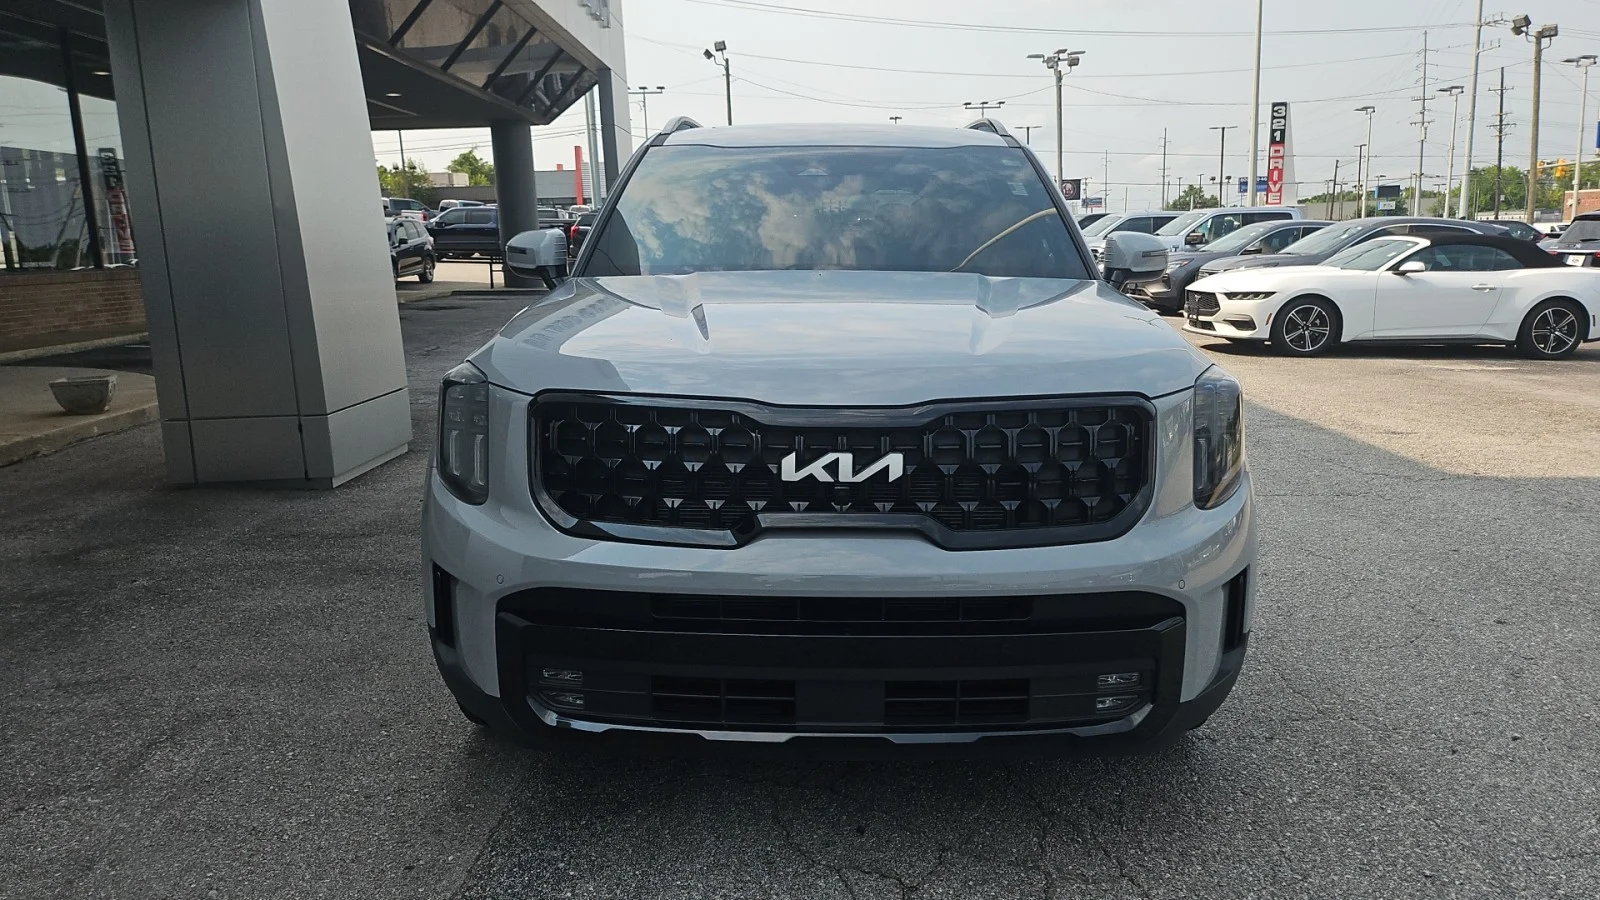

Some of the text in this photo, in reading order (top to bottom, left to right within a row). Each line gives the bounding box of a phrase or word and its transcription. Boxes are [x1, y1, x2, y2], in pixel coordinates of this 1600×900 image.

[1268, 106, 1286, 204] 321 DRIVE
[781, 451, 904, 482] KIA
